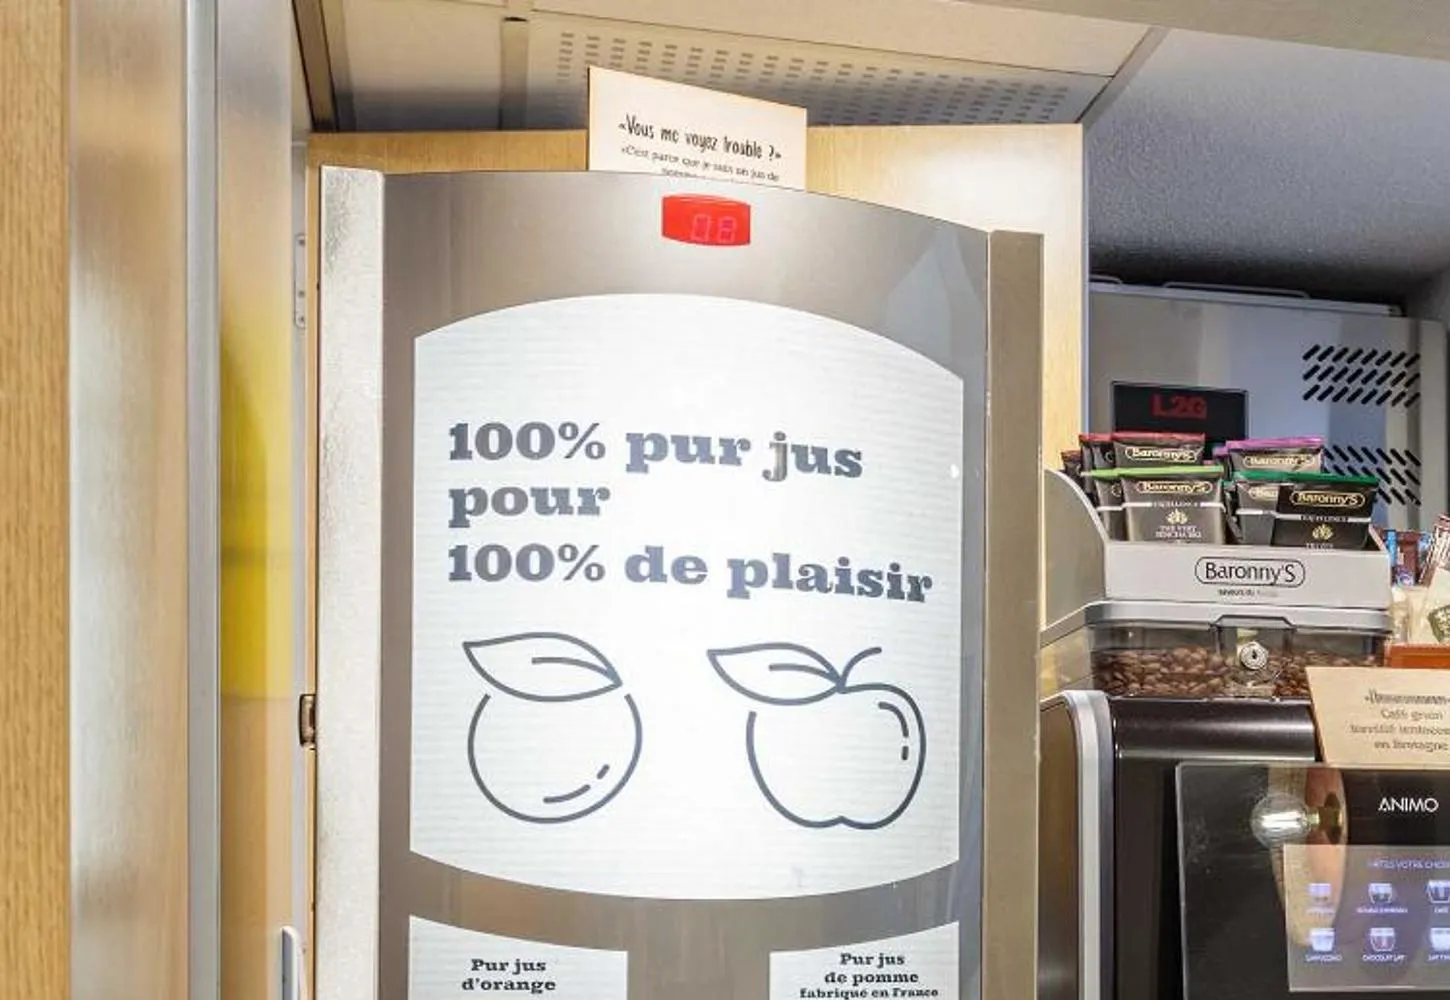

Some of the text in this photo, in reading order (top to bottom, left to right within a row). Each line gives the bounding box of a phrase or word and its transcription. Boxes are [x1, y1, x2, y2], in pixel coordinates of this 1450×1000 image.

[661, 128, 680, 145] me
[685, 132, 719, 153] voyez
[723, 136, 763, 160] trouble
[448, 421, 864, 482] 100% pur jus
[448, 485, 611, 529] pour
[448, 543, 934, 603] 100% de plaisir
[1205, 562, 1296, 585] Baronny'S
[1378, 797, 1440, 813] ANIMO
[470, 957, 547, 976] Pur jus
[839, 952, 905, 969] Pur jus
[461, 976, 556, 994] d'orange
[824, 971, 919, 987] de pomme
[799, 986, 939, 1000] fabriqué en France
